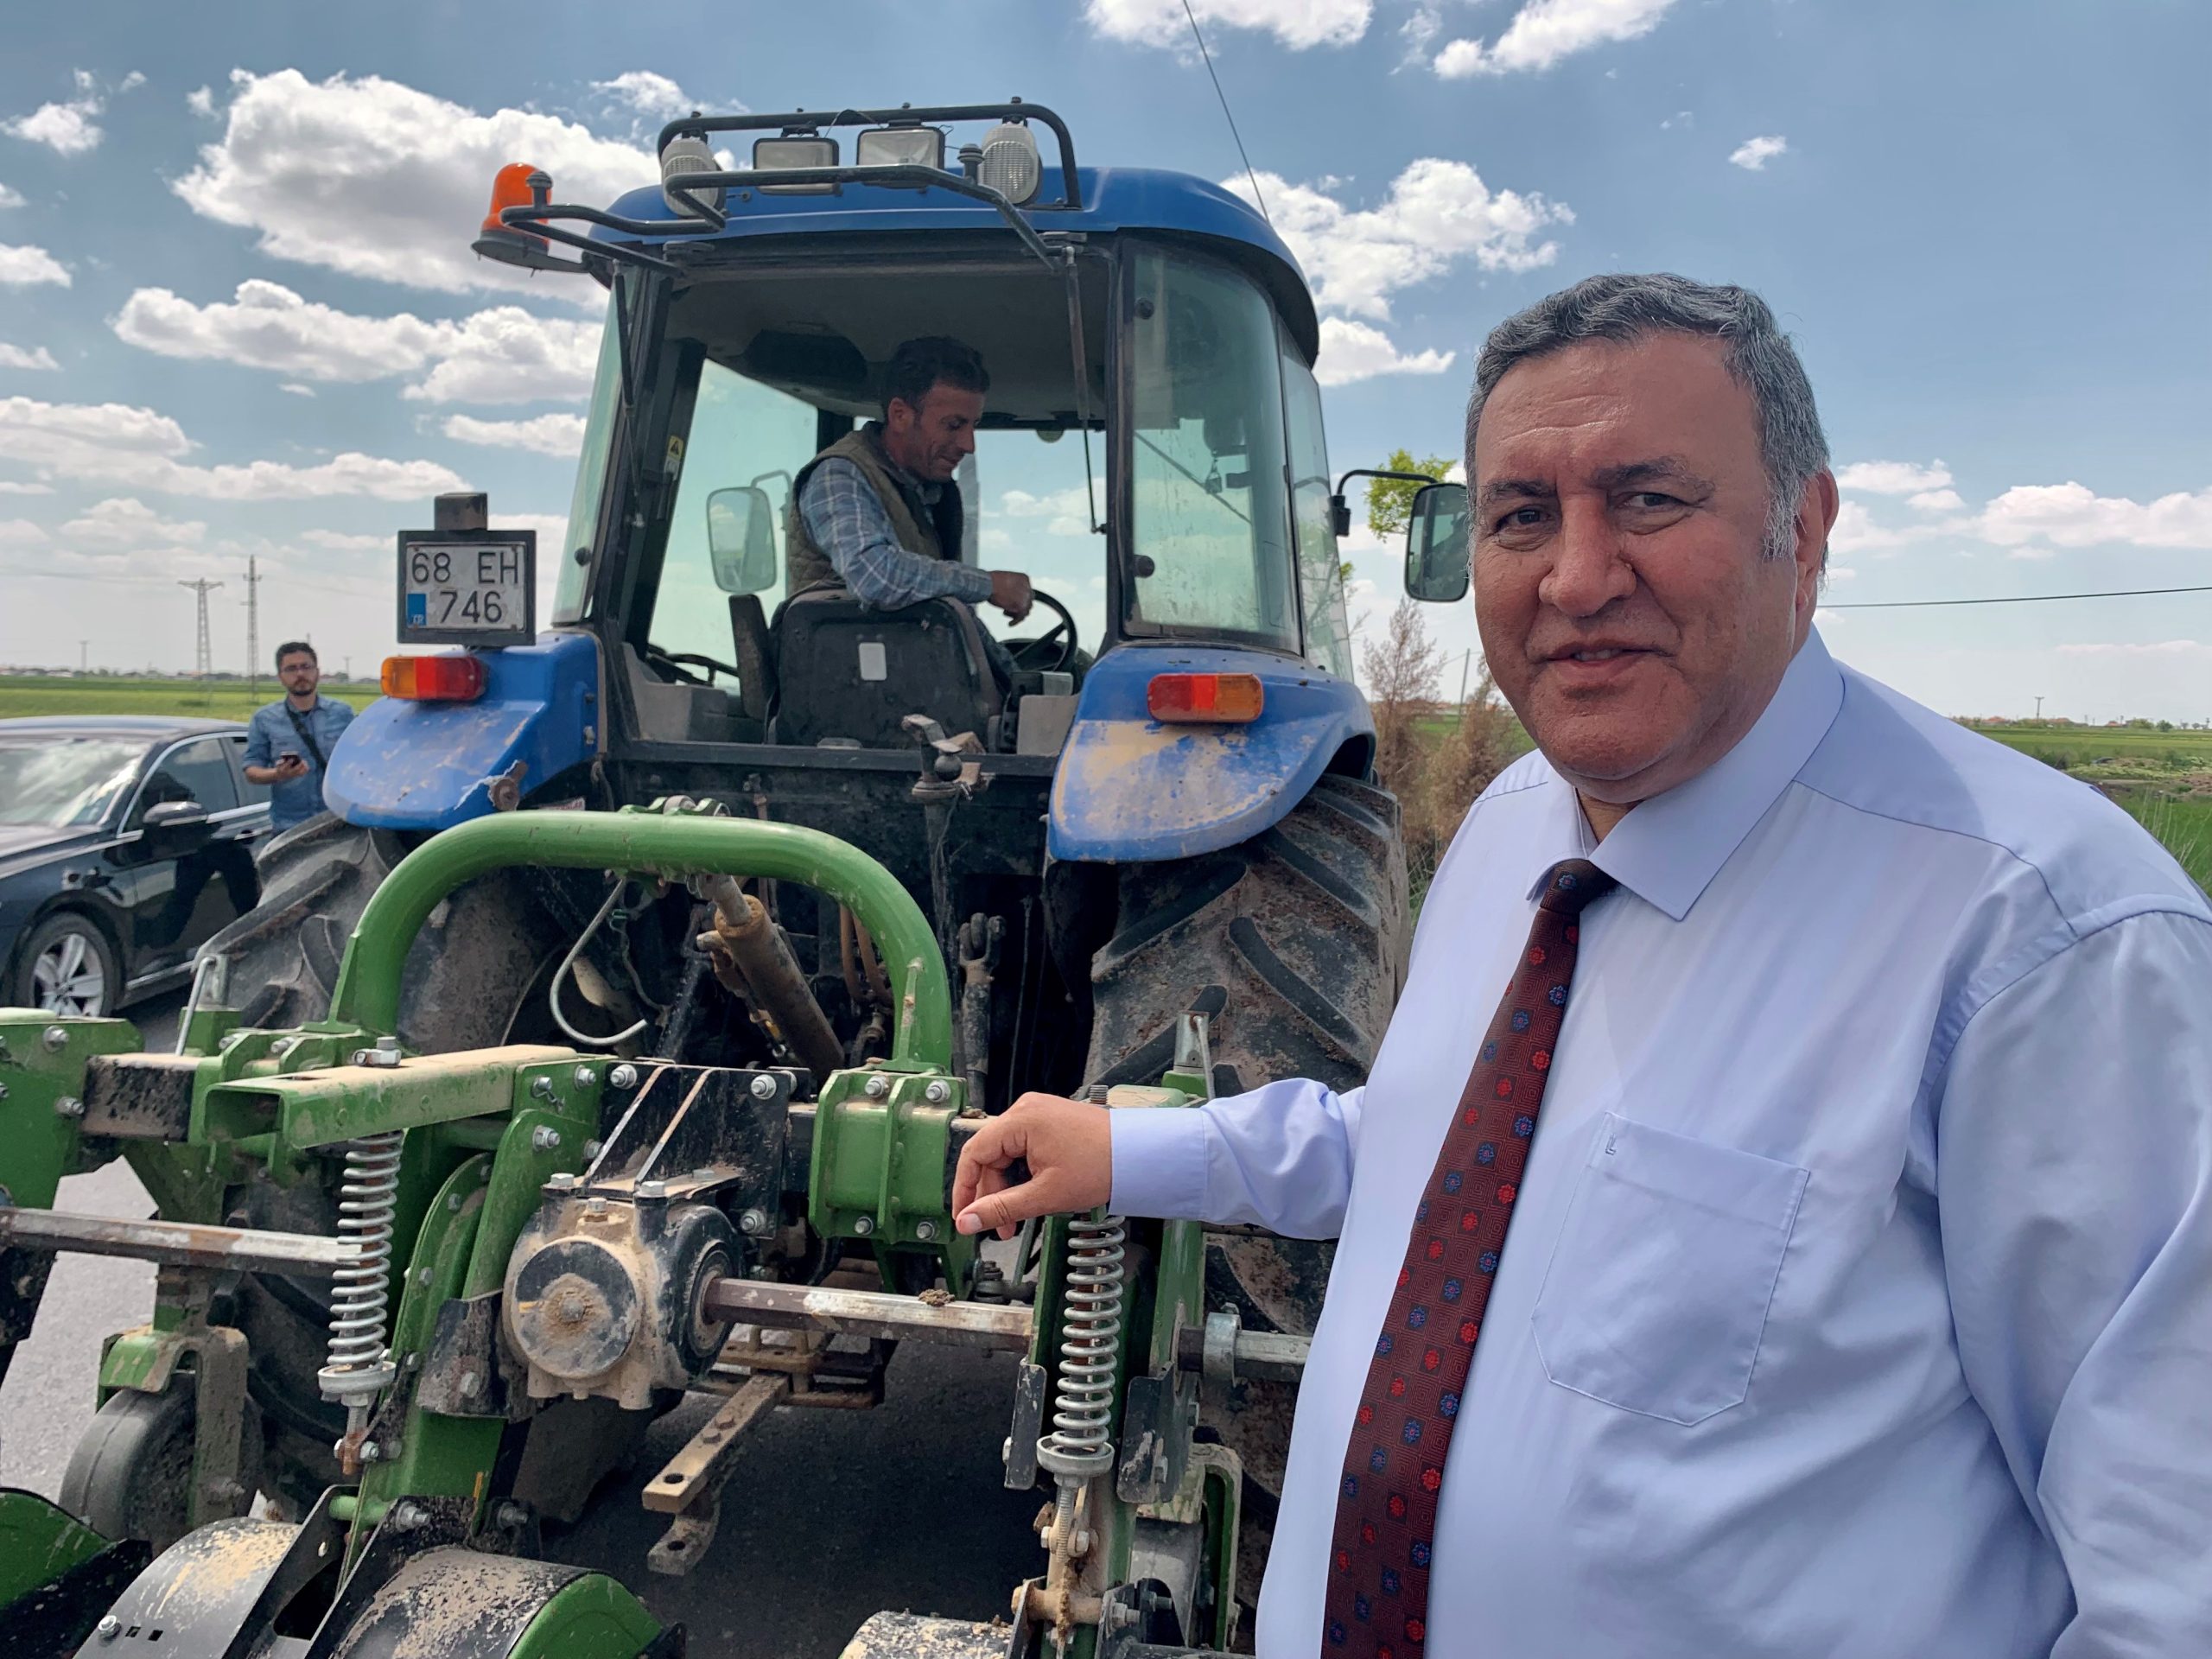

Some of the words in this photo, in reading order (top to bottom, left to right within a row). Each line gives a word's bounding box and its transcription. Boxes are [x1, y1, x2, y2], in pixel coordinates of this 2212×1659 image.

[412, 552, 450, 583] 68
[478, 551, 518, 584] EH
[440, 590, 502, 623] 746
